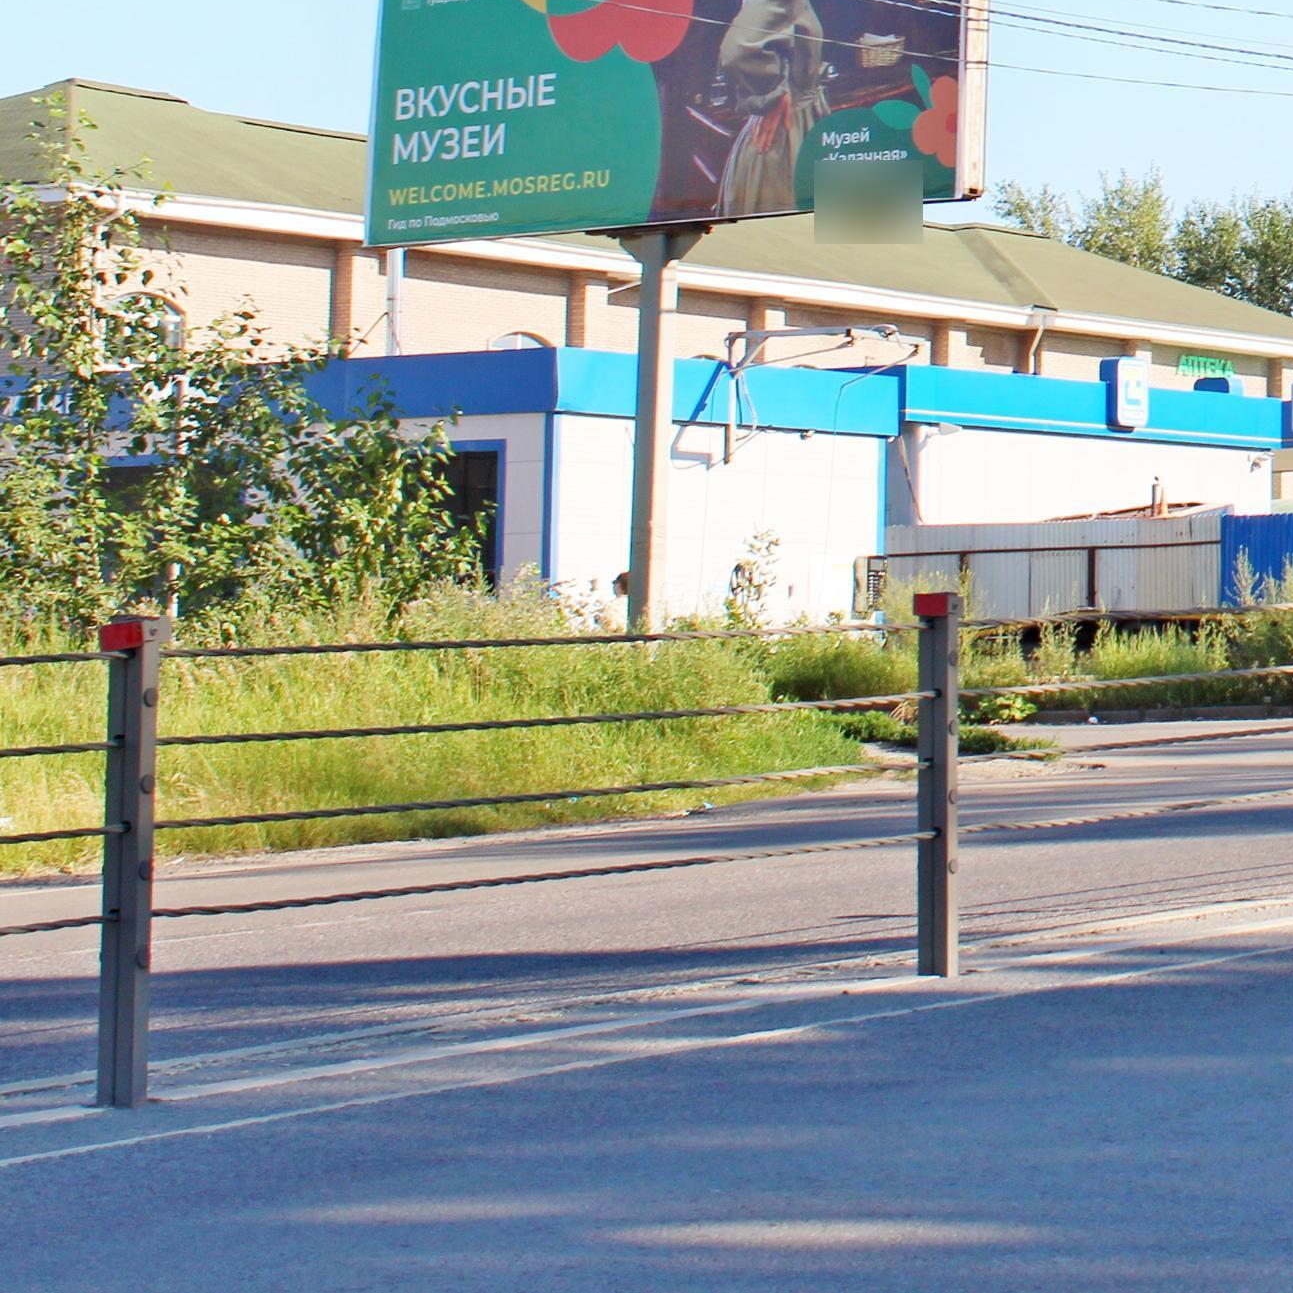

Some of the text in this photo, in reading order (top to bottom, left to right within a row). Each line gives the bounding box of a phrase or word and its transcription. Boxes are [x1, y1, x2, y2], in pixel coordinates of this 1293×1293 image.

[394, 72, 557, 121] ВКУСНЫЕ
[391, 123, 506, 165] МУЗЕИ
[822, 127, 871, 149] Музей
[388, 169, 611, 206] WELCOME.MOSREG.RU
[387, 211, 500, 231] Гид по Подмосковью
[1177, 355, 1235, 377] АПТЕКА
